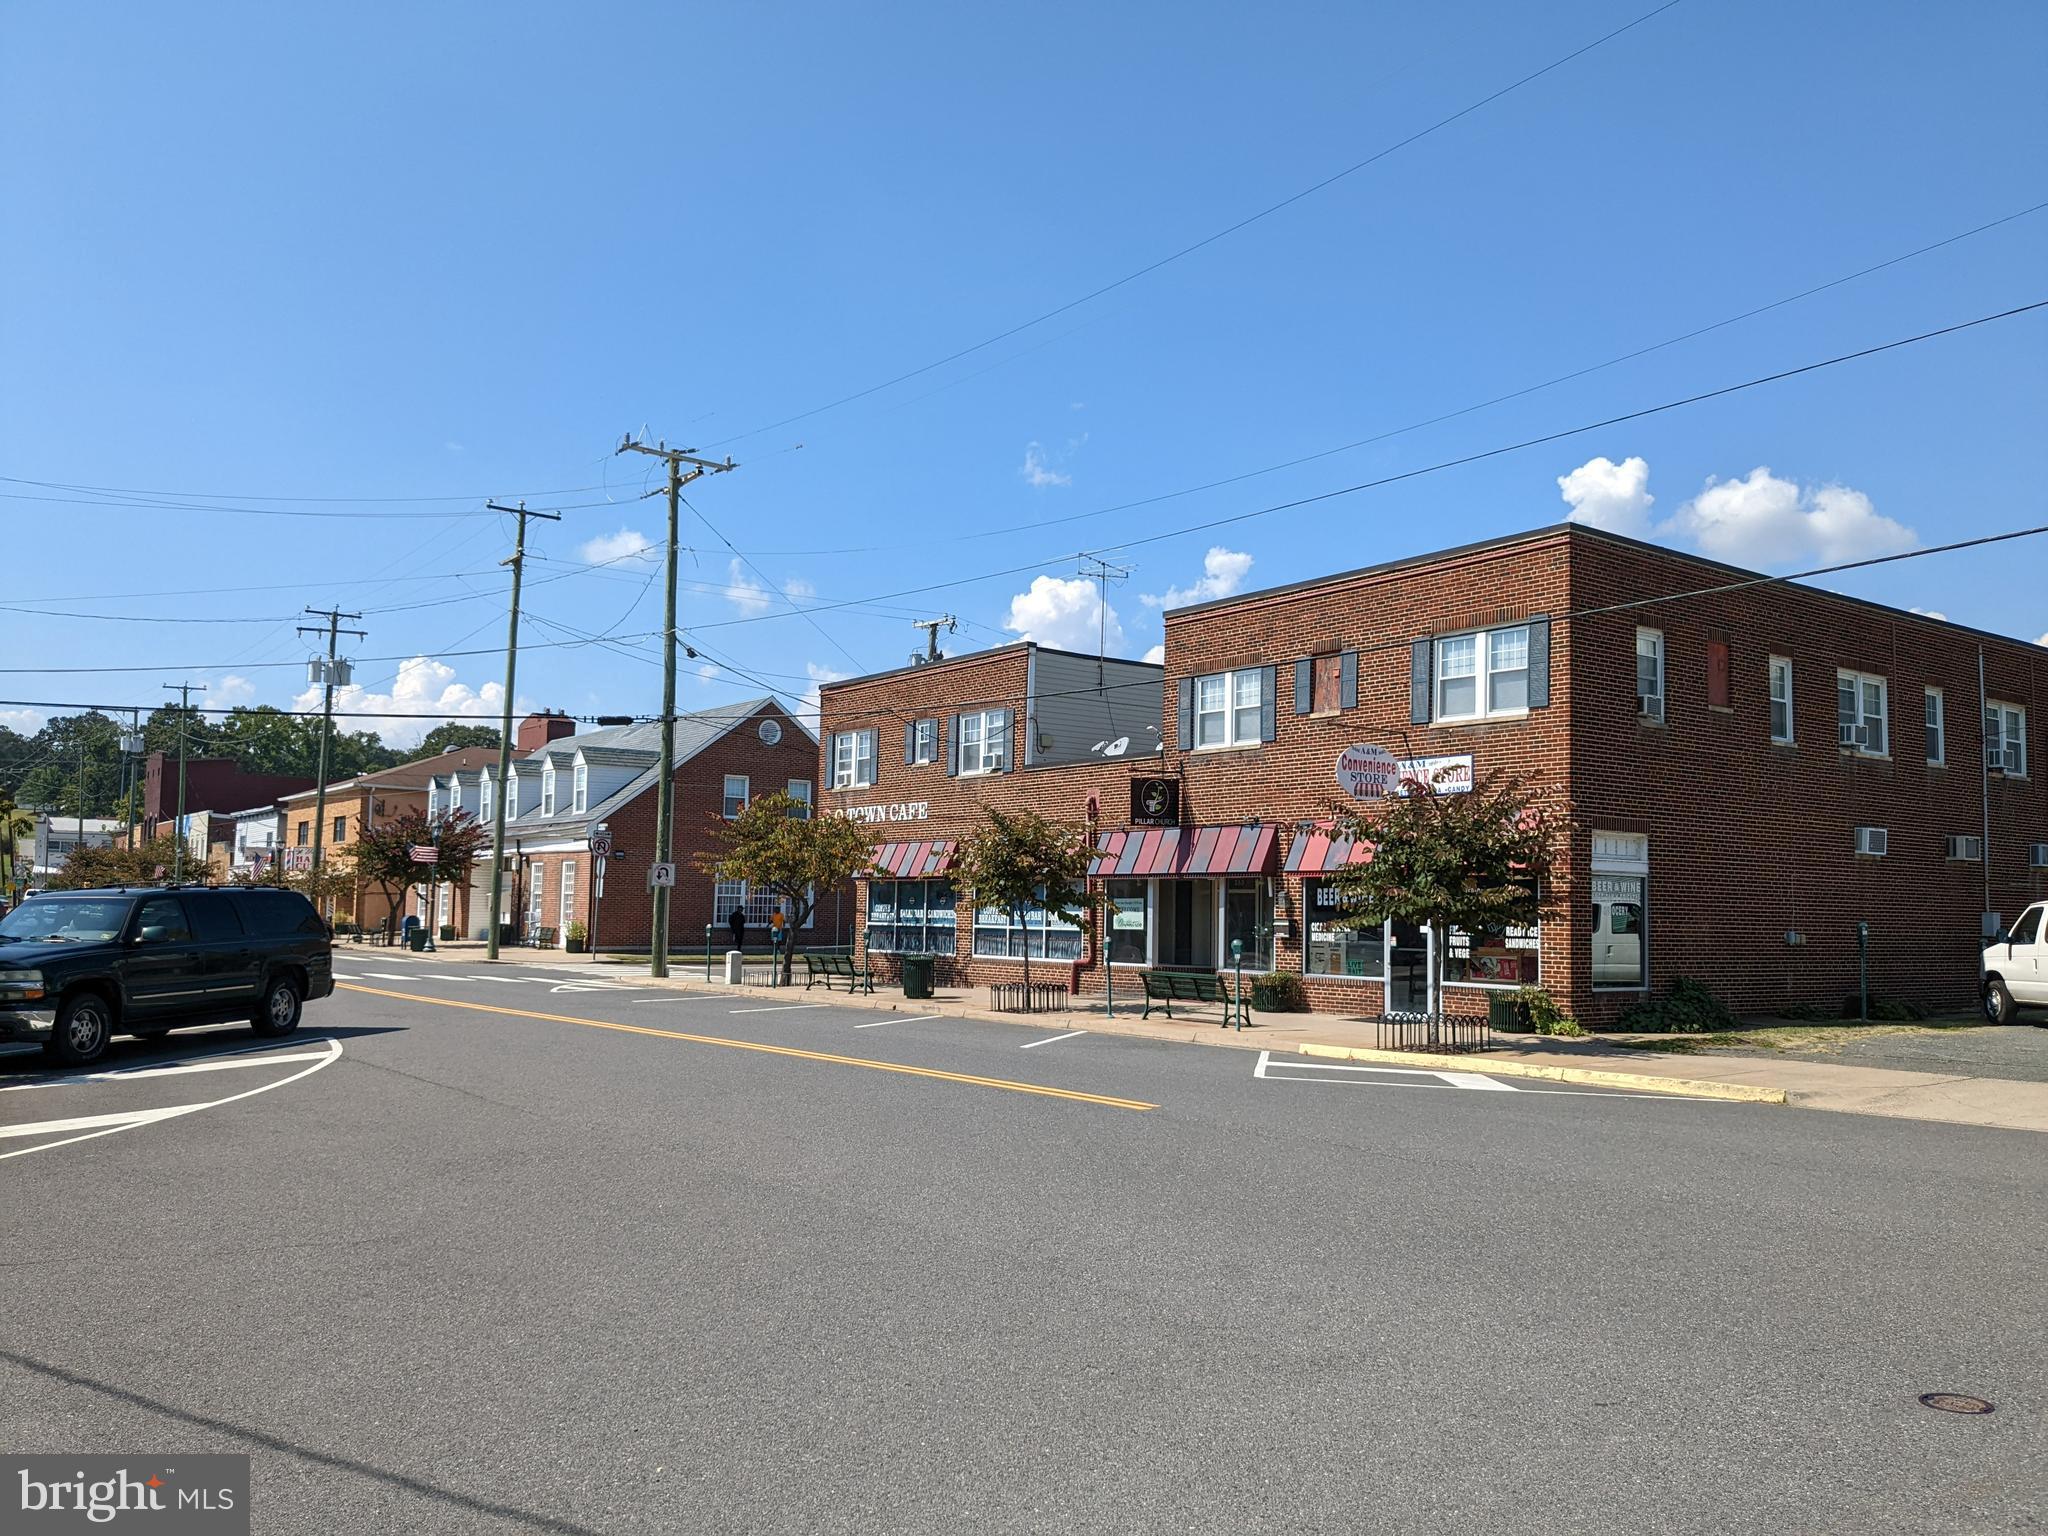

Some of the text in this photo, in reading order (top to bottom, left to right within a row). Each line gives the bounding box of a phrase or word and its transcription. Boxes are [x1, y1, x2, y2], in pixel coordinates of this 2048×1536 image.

[1341, 754, 1396, 775] Convenience
[1350, 771, 1388, 785] STORE
[846, 806, 886, 823] TOWN
[890, 802, 928, 821] CAFE
[1134, 817, 1176, 826] PILLAR CHURCH
[1592, 880, 1612, 892] BEER
[1620, 881, 1641, 893] WINE
[1317, 887, 1340, 906] BEER
[1032, 911, 1042, 921] BAR
[1311, 932, 1335, 942] MEDICINE
[1449, 936, 1470, 946] FRUITS
[1505, 938, 1538, 949] SANDWICHES
[1449, 948, 1470, 959] & VEGE
